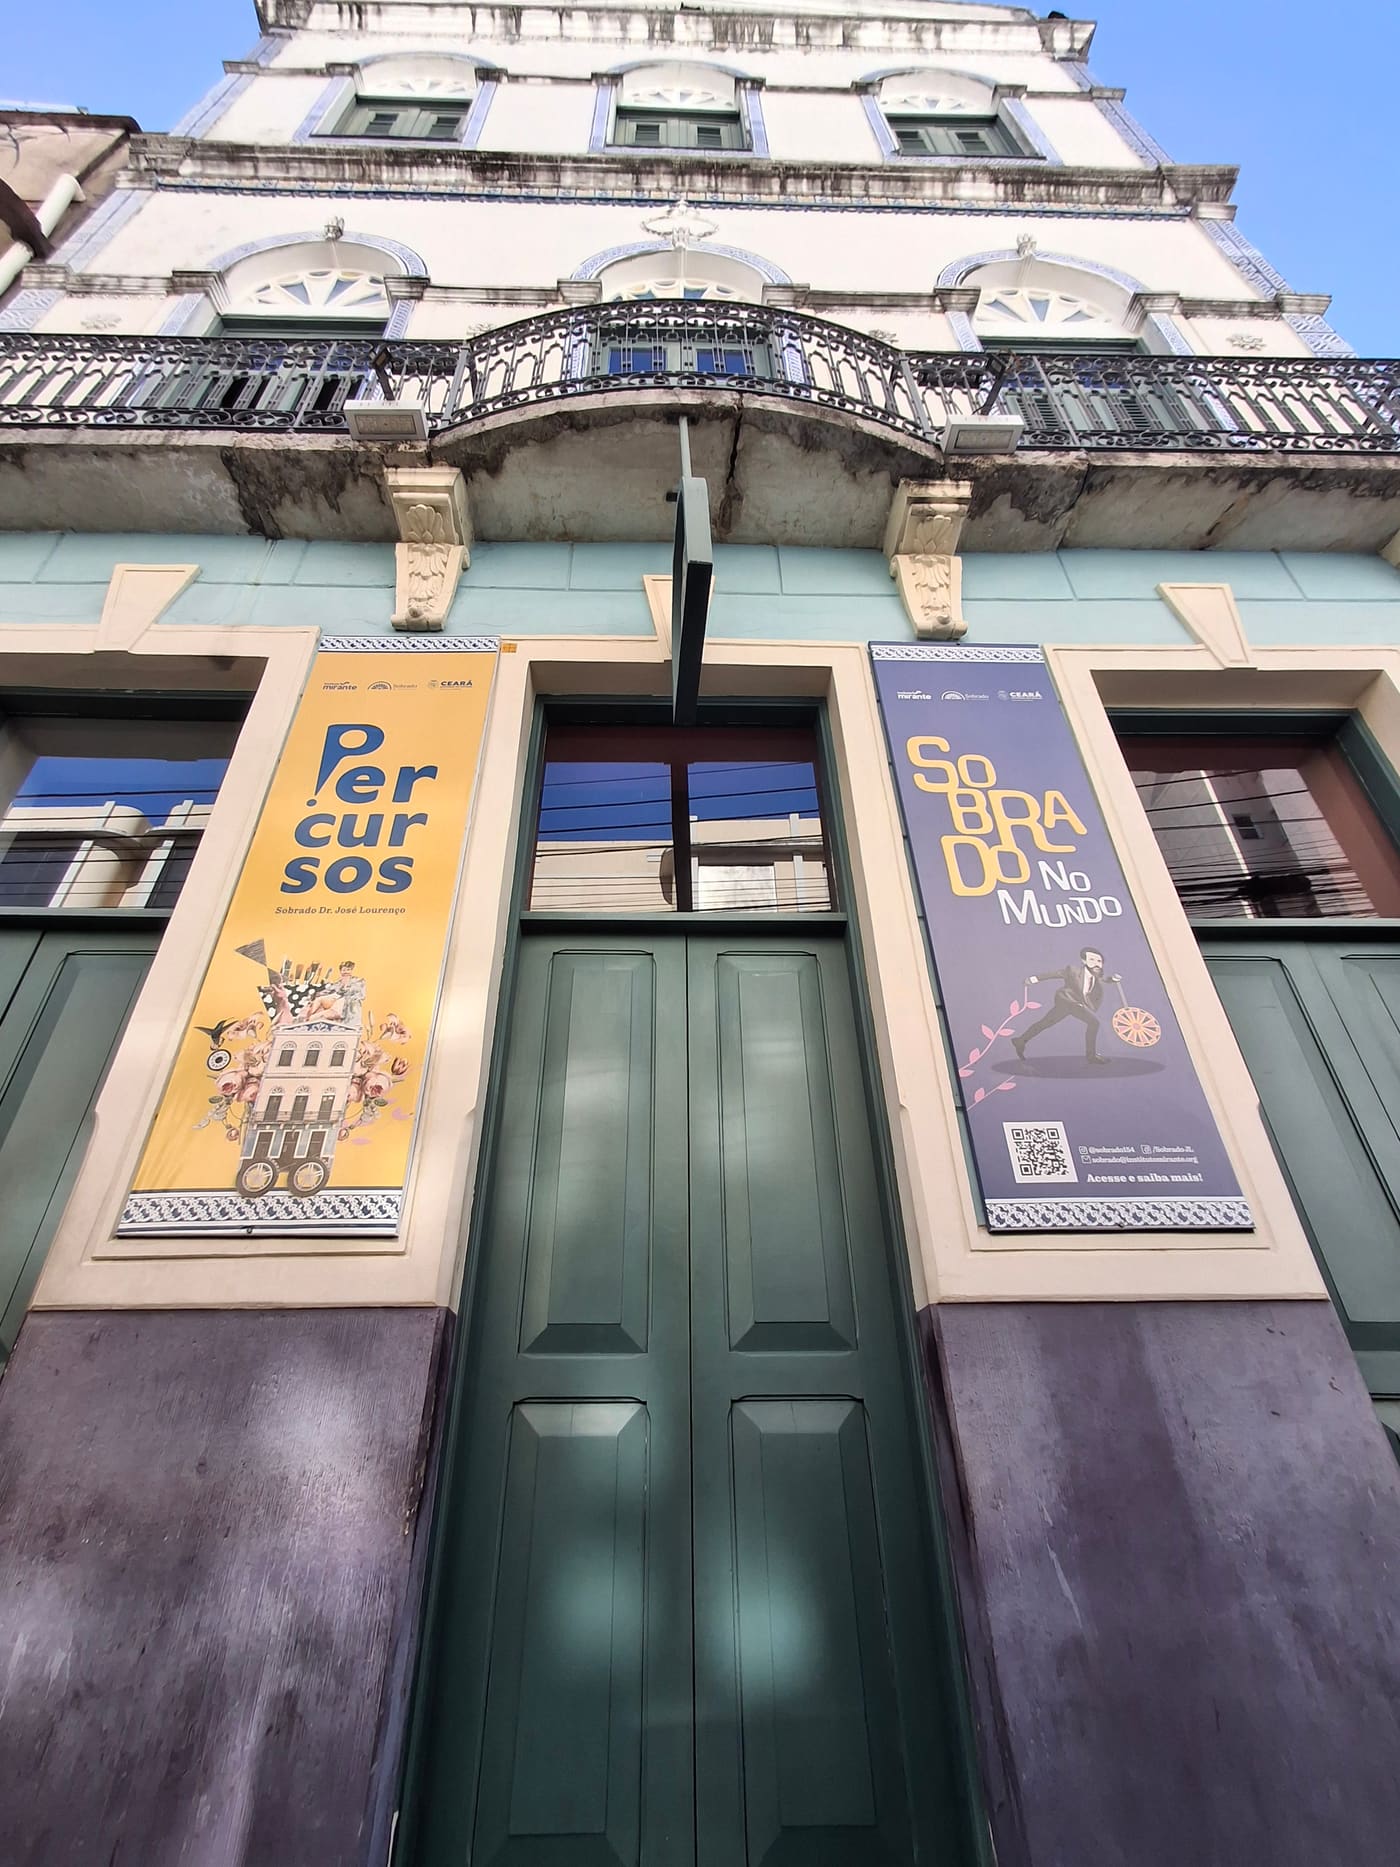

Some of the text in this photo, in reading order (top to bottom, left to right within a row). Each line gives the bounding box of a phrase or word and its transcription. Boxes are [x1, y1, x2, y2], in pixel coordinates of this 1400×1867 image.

[294, 812, 429, 848] cur
[279, 855, 415, 894] sos
[275, 904, 406, 916] Sobrado Dr. José Lourenço
[1087, 1173, 1127, 1182] Acesse
[1136, 1173, 1170, 1182] saiba
[1170, 1173, 1204, 1182] mais!
